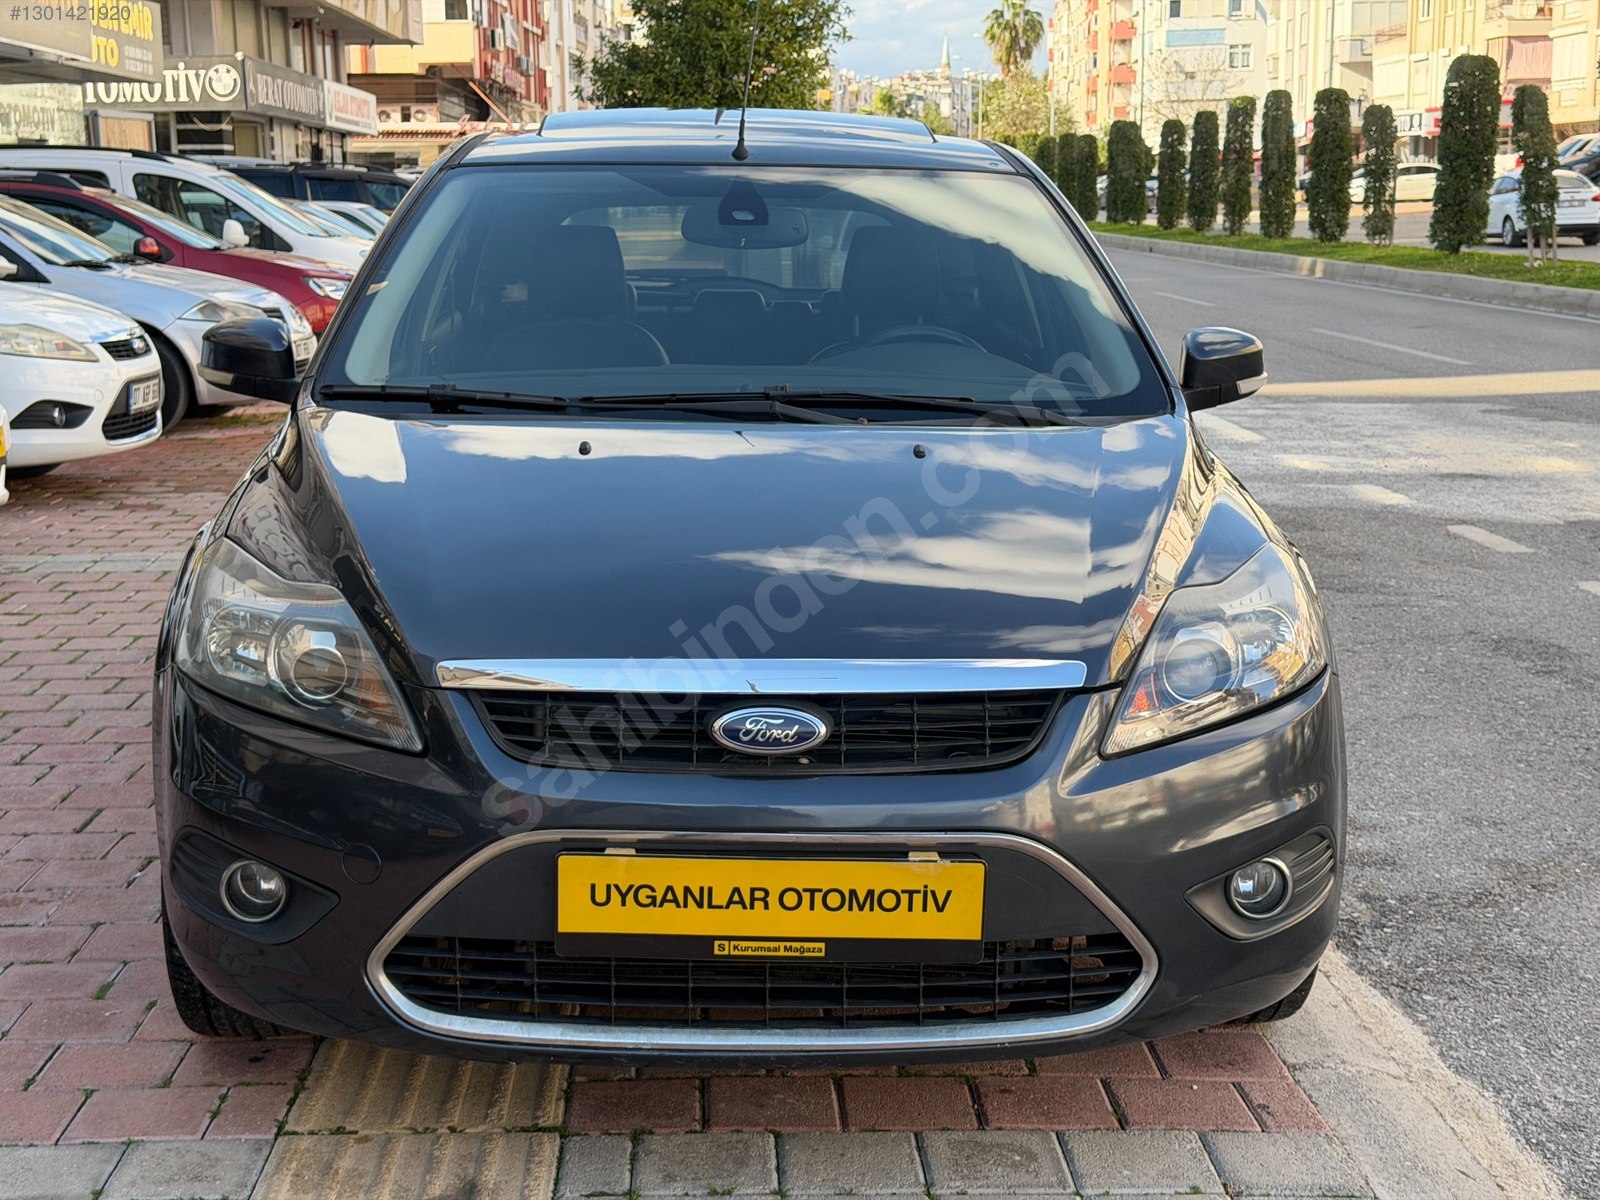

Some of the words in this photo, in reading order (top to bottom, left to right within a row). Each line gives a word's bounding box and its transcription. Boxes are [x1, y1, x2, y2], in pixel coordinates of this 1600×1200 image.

[739, 717, 799, 742] Ford
[589, 882, 770, 911] UYGANLAR
[778, 884, 953, 913] OTOMOTİV
[732, 943, 781, 953] Kurumsal
[783, 944, 823, 955] Mağaza
